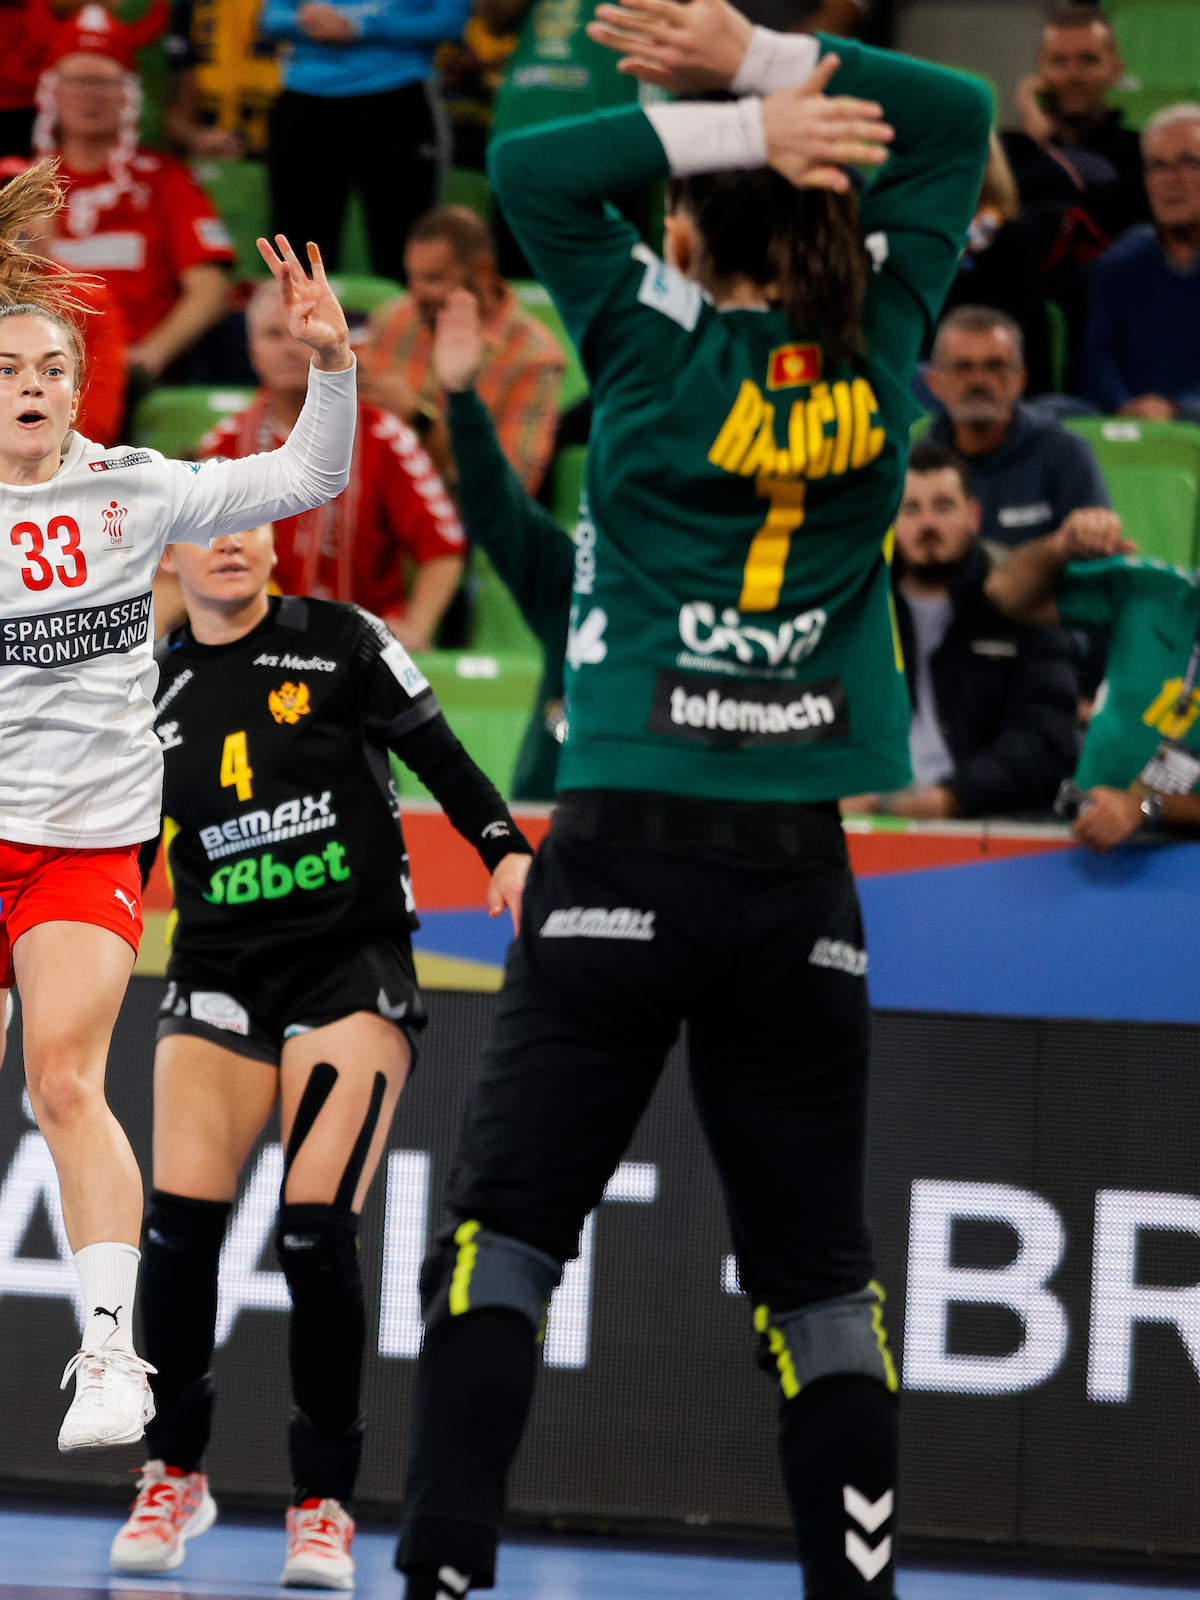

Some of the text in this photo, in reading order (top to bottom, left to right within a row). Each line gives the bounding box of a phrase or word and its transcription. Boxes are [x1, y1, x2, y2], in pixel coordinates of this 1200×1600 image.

[10, 515, 88, 591] 33
[110, 537, 123, 545] DHF
[2, 596, 151, 642] SPAREKASSEN
[4, 620, 148, 664] KRONJYLLAND
[253, 654, 337, 673] Ars Medica
[670, 686, 835, 734] telemach
[220, 730, 253, 802] 4
[199, 791, 333, 851] BEMAX
